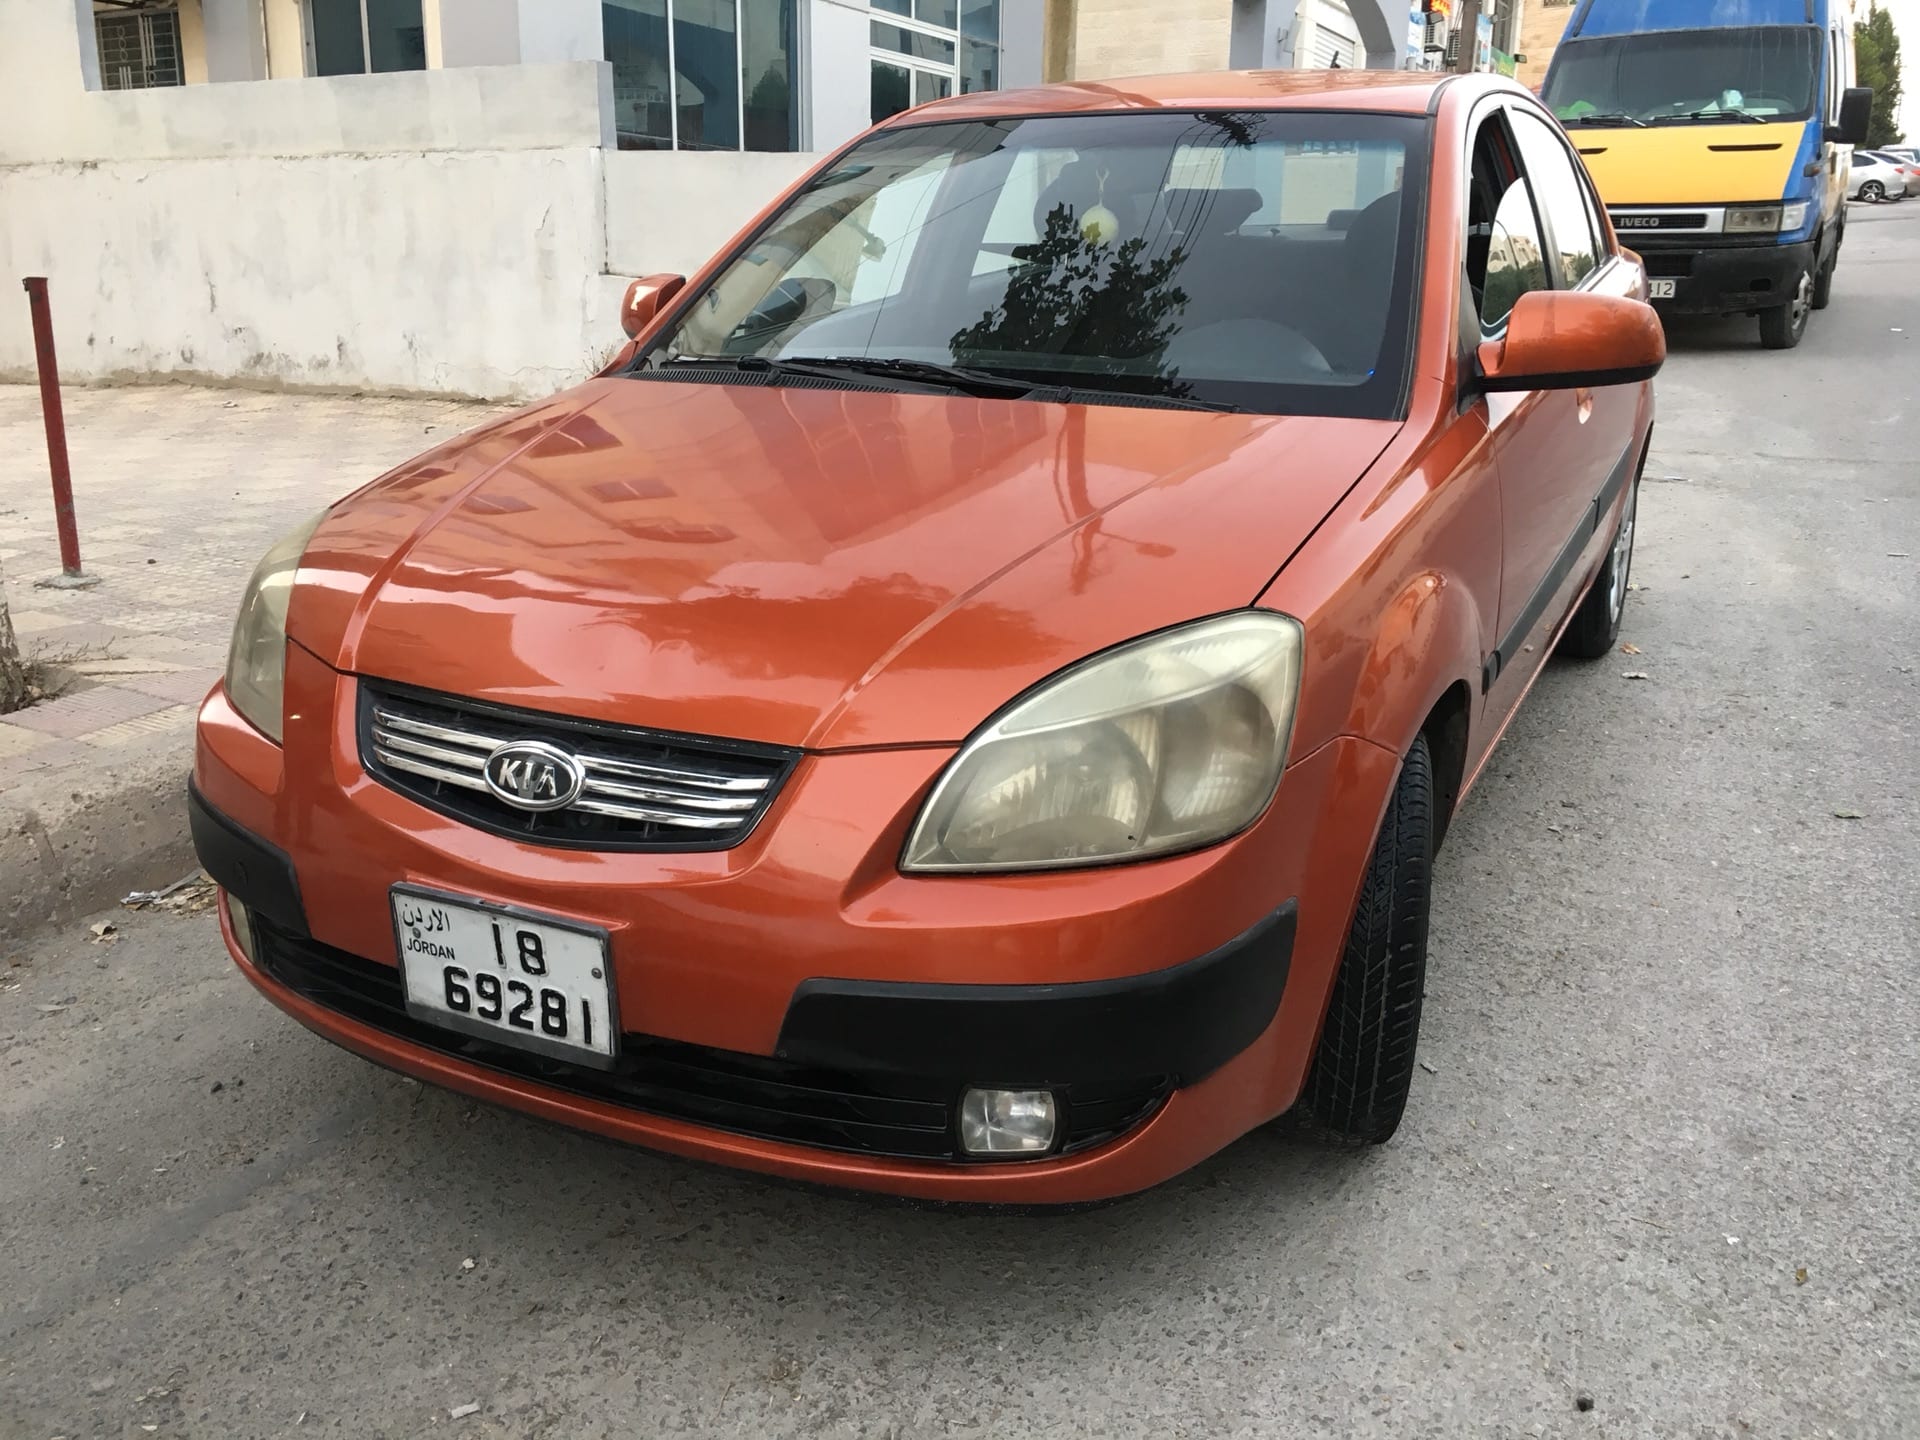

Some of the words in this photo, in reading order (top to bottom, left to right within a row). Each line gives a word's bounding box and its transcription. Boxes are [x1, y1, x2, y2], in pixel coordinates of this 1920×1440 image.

[1620, 217, 1660, 227] IVECO
[498, 757, 557, 797] KIA
[407, 938, 456, 961] JORDAN
[443, 966, 592, 1045] 69281
